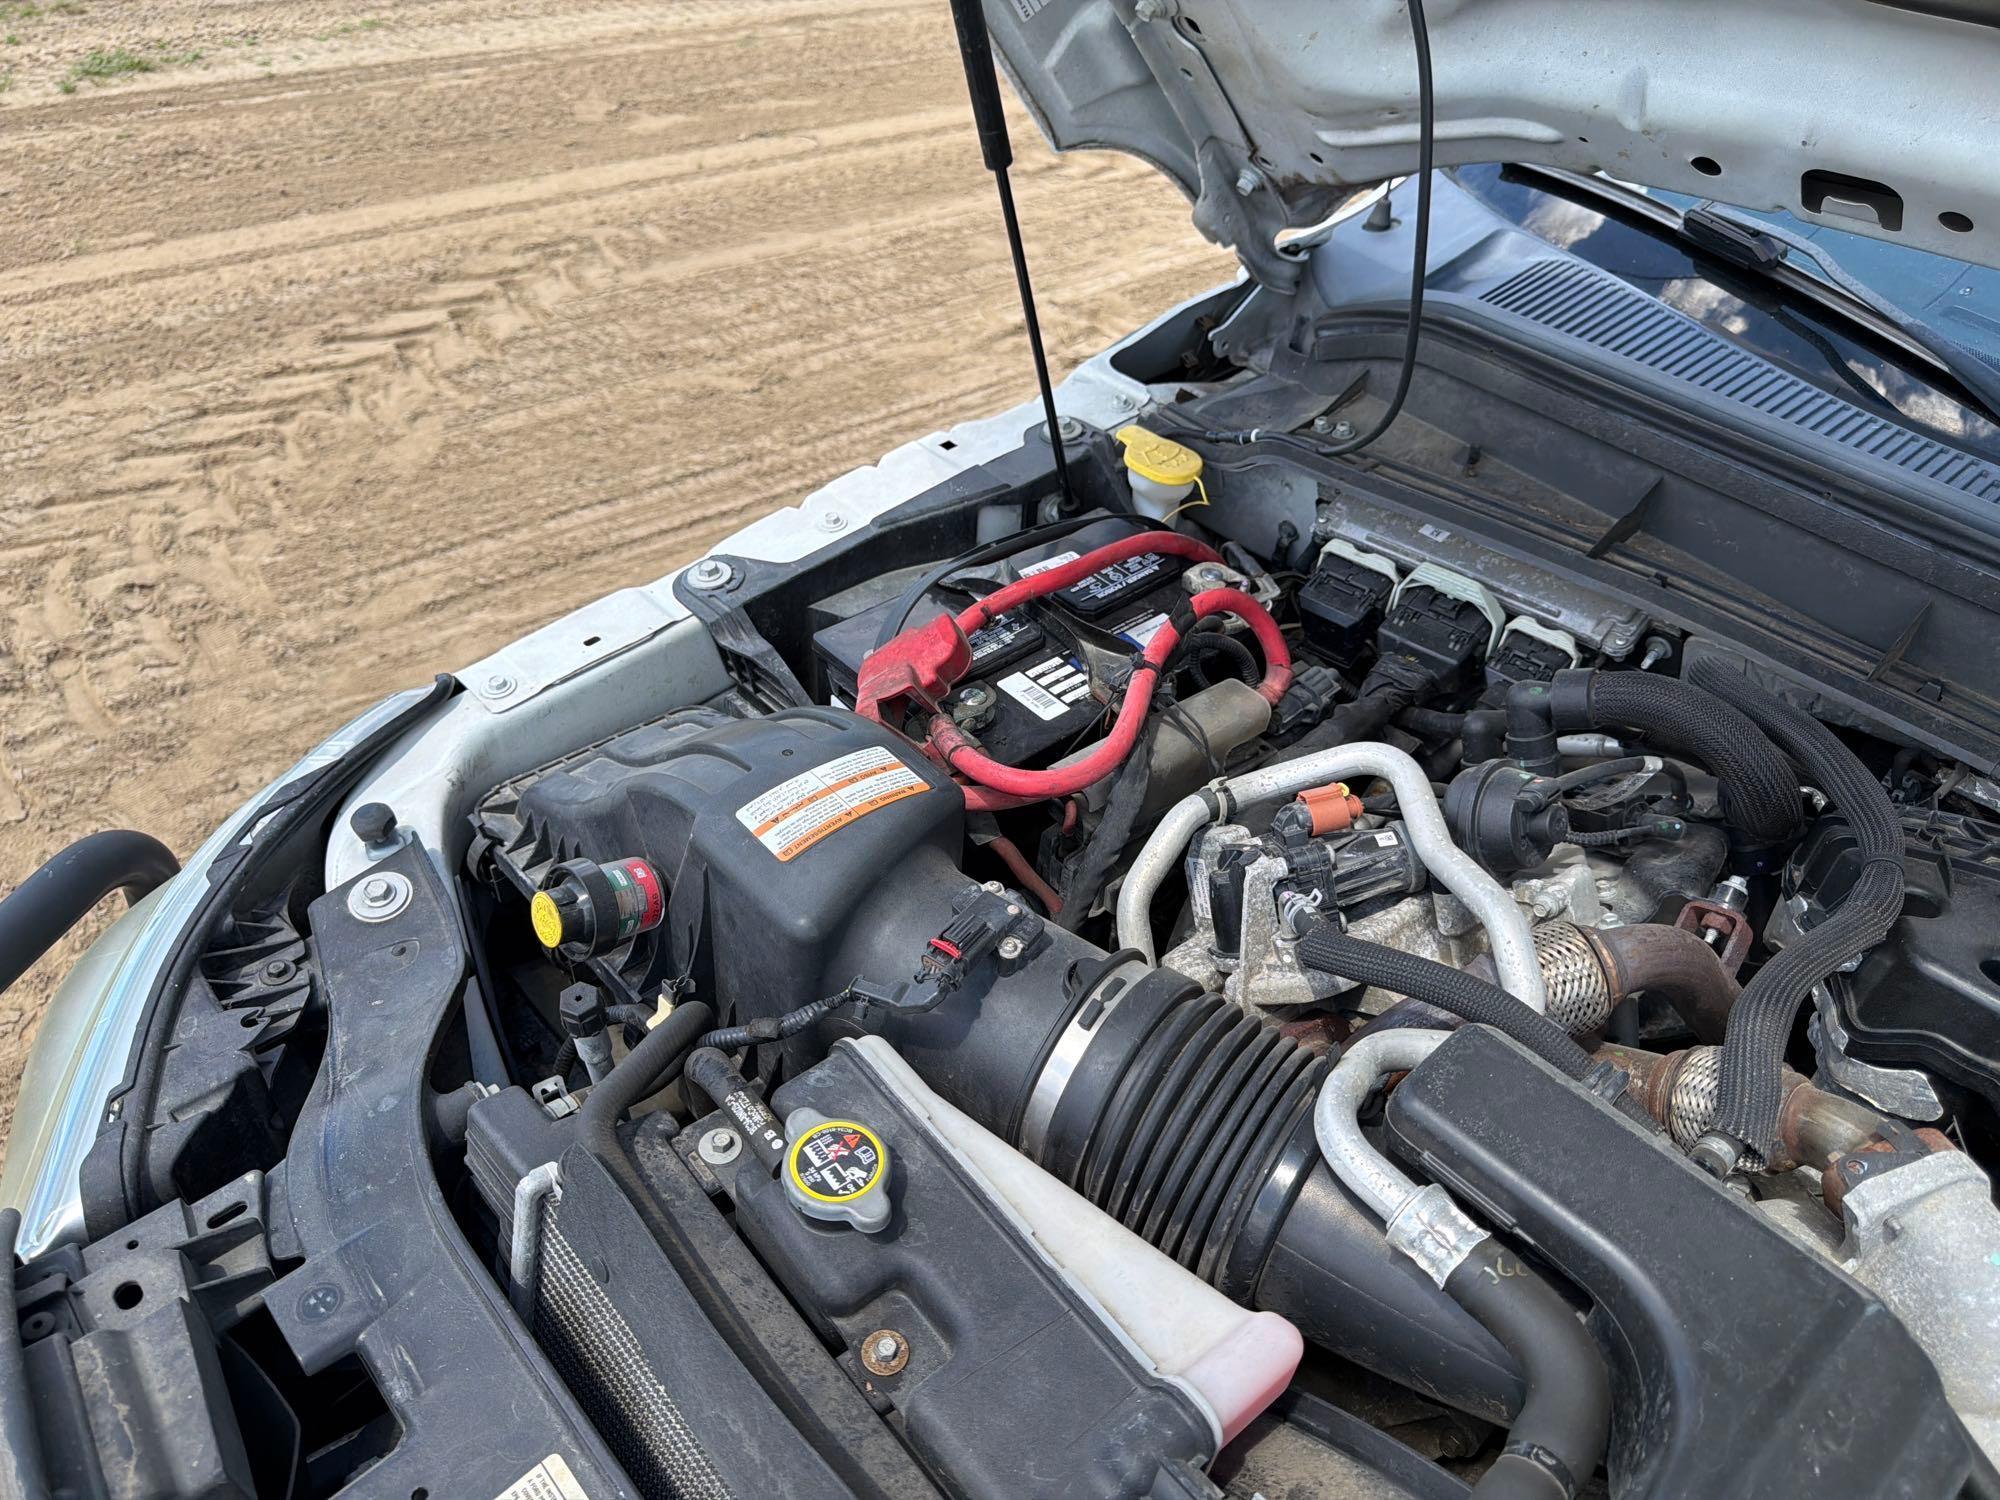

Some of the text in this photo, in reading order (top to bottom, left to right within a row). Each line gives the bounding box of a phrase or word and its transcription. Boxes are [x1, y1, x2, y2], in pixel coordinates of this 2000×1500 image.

[1127, 567, 1152, 585] DANGER
[1096, 584, 1121, 599] POISON
[880, 790, 907, 802] WARNING
[794, 818, 843, 850] AVERTISSEMENT
[763, 1129, 777, 1140] B
[846, 1182, 856, 1193] OK
